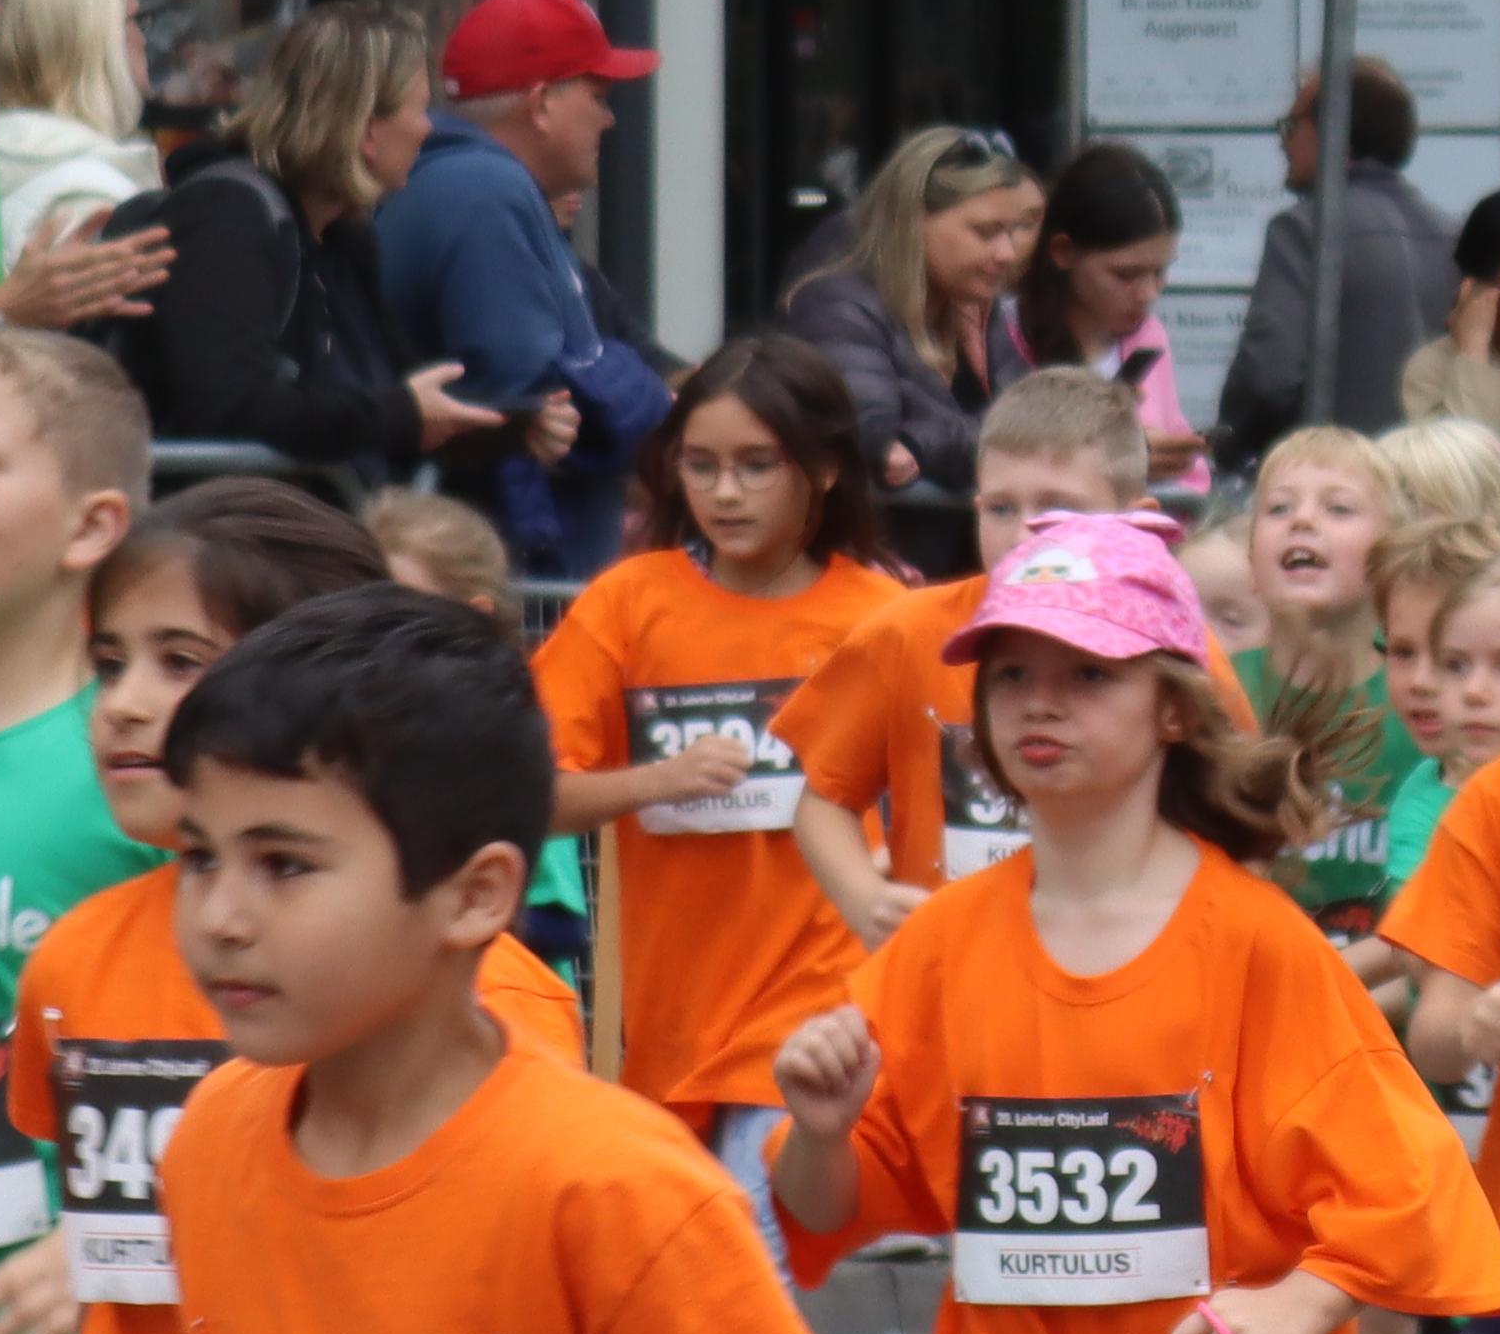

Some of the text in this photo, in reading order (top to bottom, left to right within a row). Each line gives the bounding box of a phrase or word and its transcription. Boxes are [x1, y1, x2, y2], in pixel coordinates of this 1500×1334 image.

[1015, 1112, 1056, 1127] Lehrter
[1057, 1111, 1110, 1130] CityLauf
[978, 1147, 1162, 1226] 3532
[1000, 1252, 1132, 1275] KURTULUS
